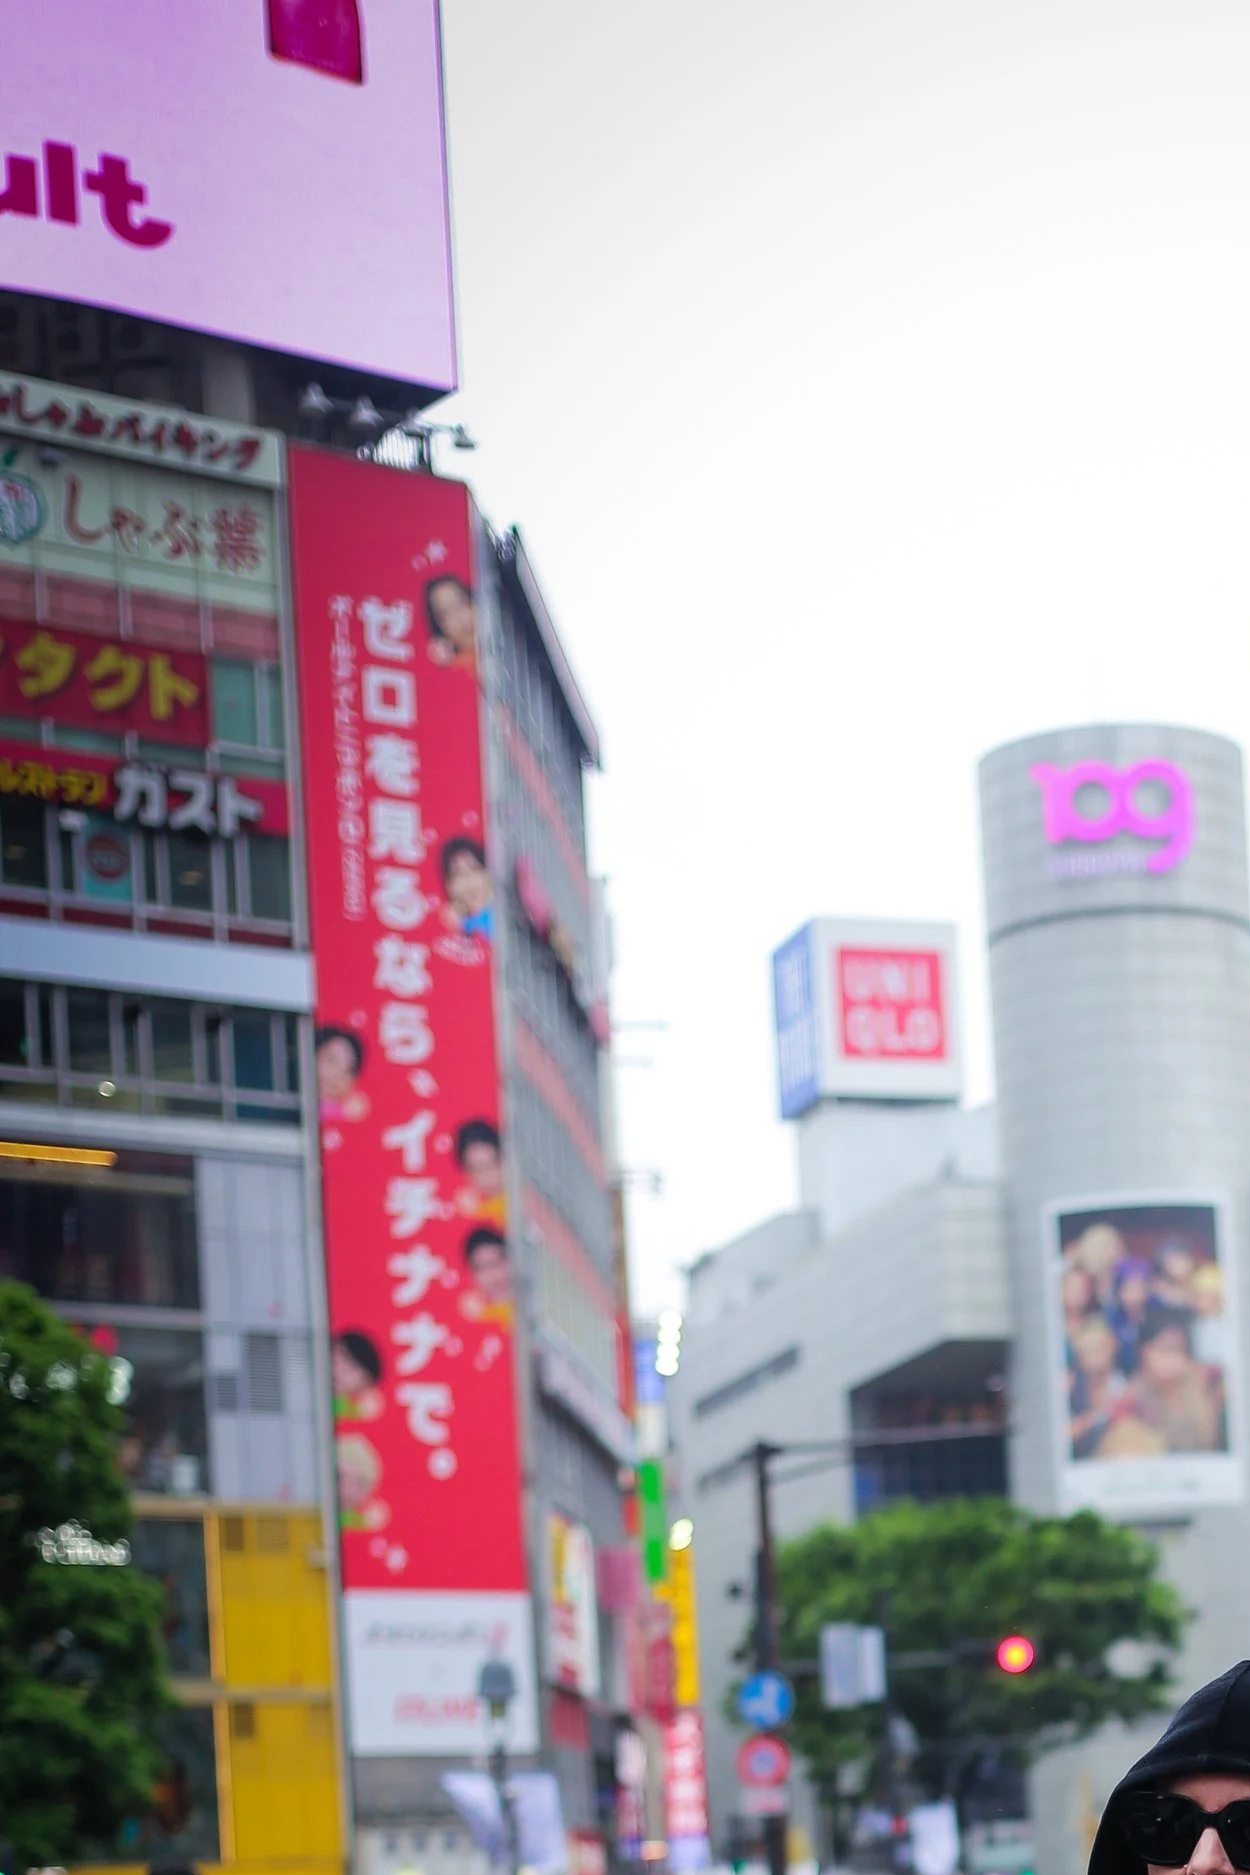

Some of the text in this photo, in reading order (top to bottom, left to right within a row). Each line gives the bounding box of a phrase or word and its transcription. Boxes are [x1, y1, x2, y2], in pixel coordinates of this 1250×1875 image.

[0, 380, 262, 470] しゃぶバイキング
[65, 474, 263, 572] しゃぶ葉
[0, 632, 200, 720] タクト
[112, 764, 264, 838] ガスト
[1028, 756, 1196, 875] 109
